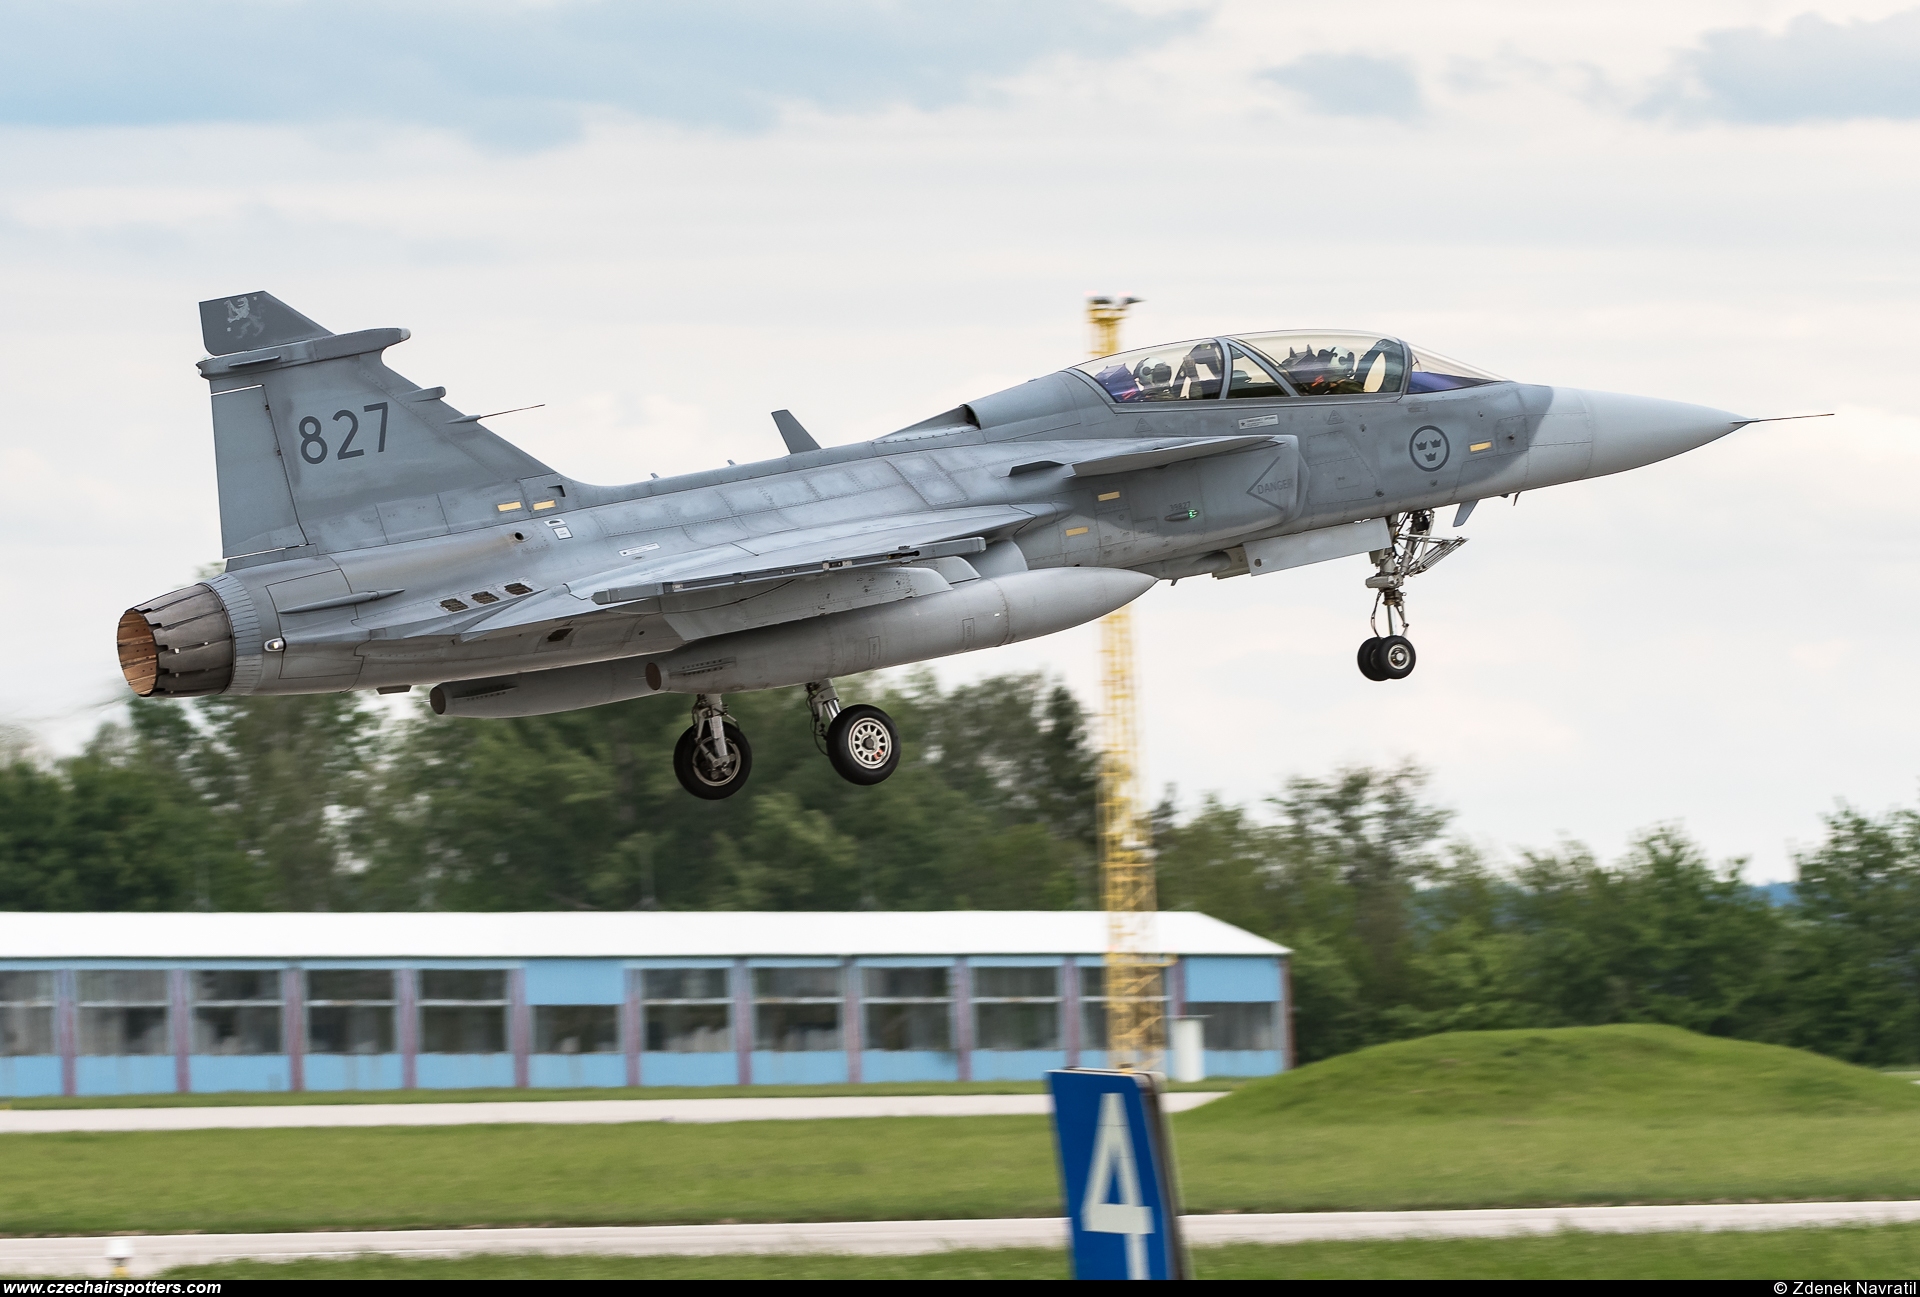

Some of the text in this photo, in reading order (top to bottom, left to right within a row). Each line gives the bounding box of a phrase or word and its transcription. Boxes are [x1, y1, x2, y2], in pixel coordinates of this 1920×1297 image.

[299, 402, 388, 464] 827
[1257, 478, 1293, 494] DANGER
[1080, 1093, 1155, 1280] 4
